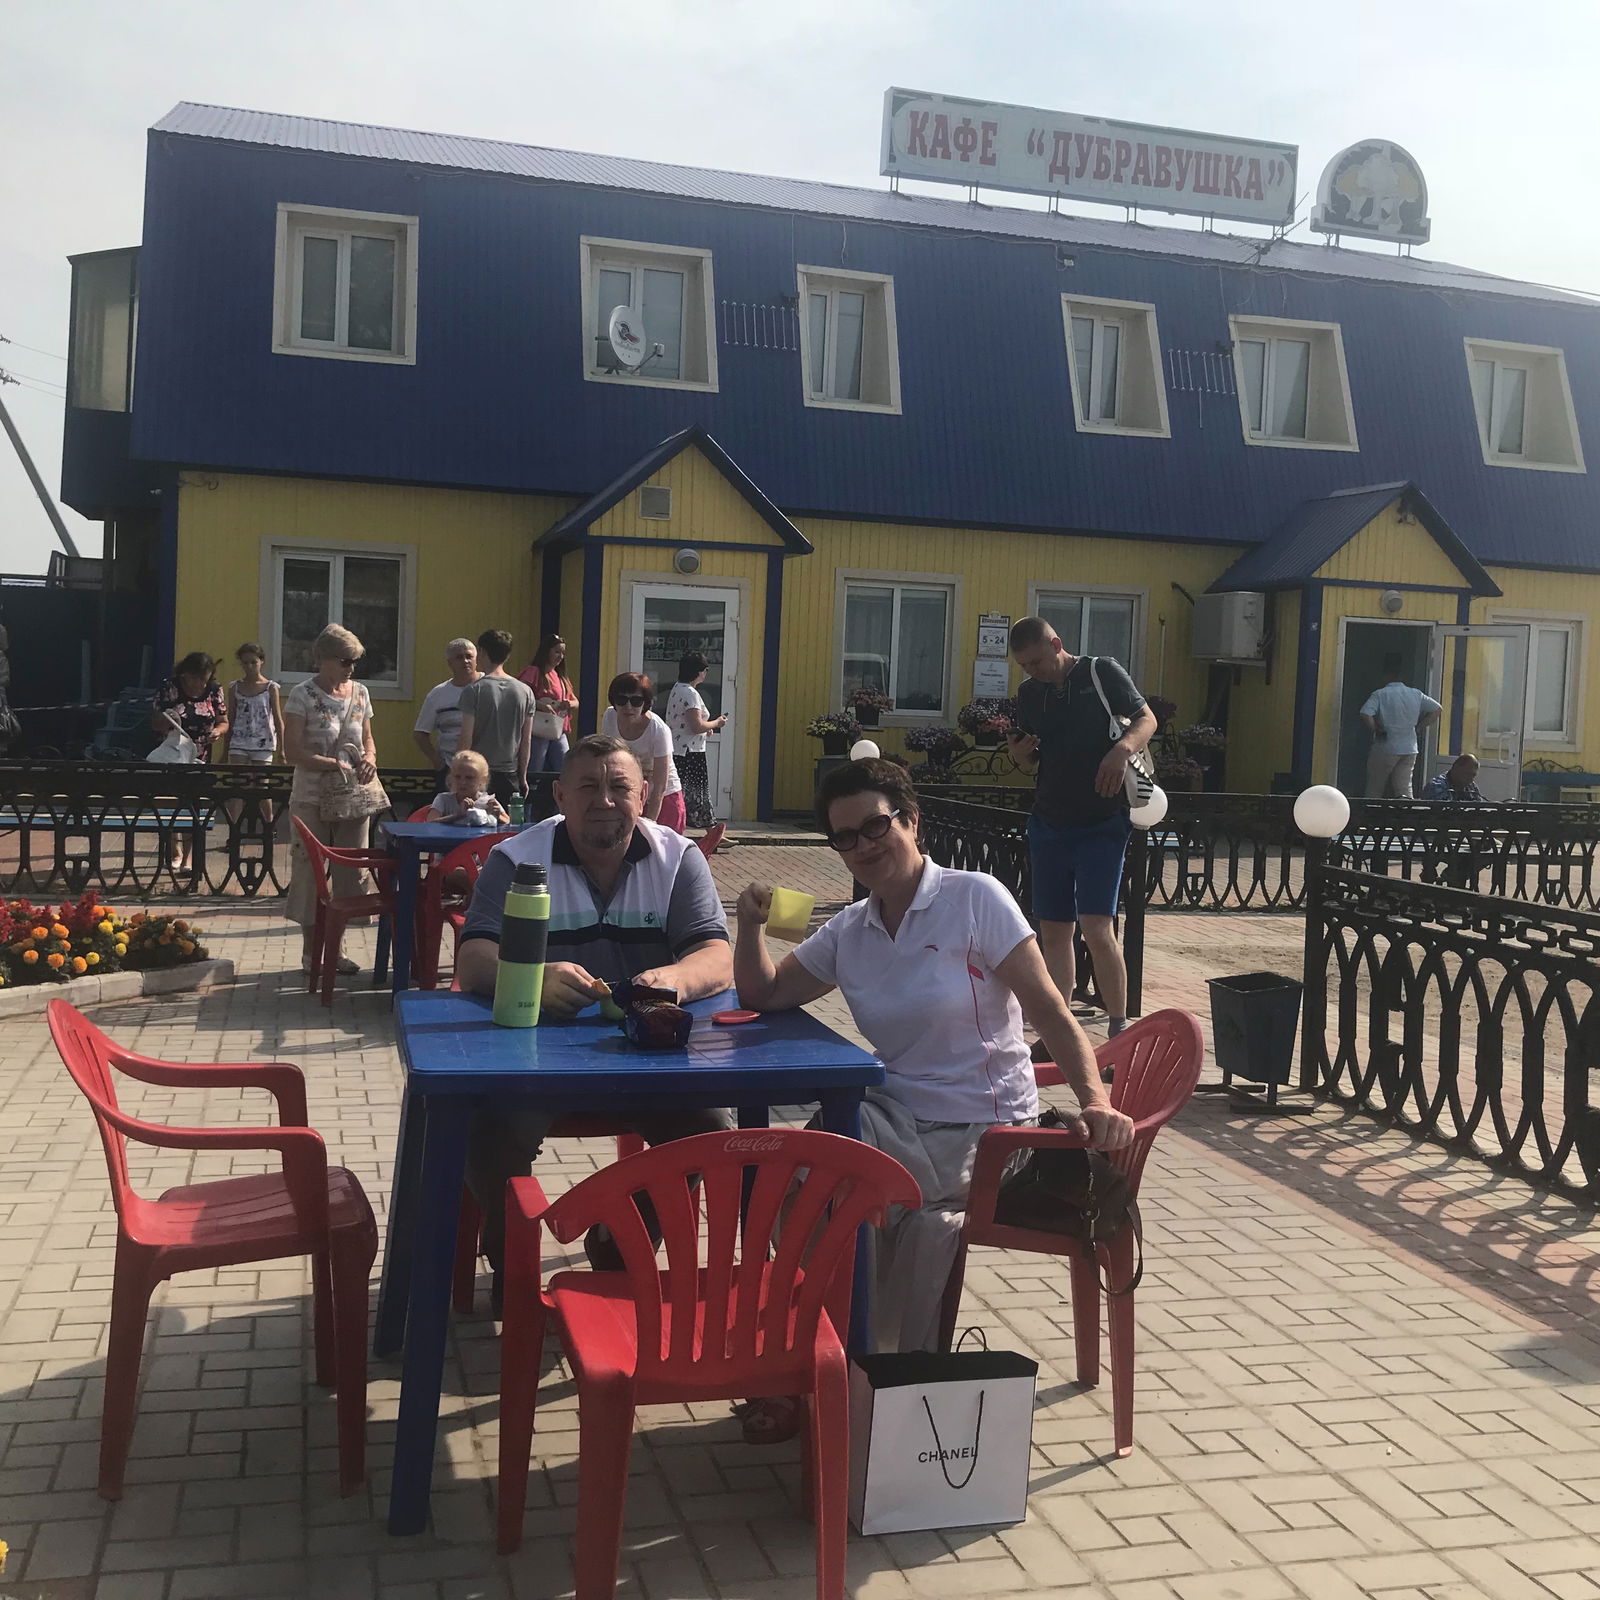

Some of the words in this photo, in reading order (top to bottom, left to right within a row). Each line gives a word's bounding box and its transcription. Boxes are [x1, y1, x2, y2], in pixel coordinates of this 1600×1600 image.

[907, 110, 998, 166] КАФЕ
[994, 635, 1005, 645] 24
[918, 1446, 978, 1463] CHANEL
